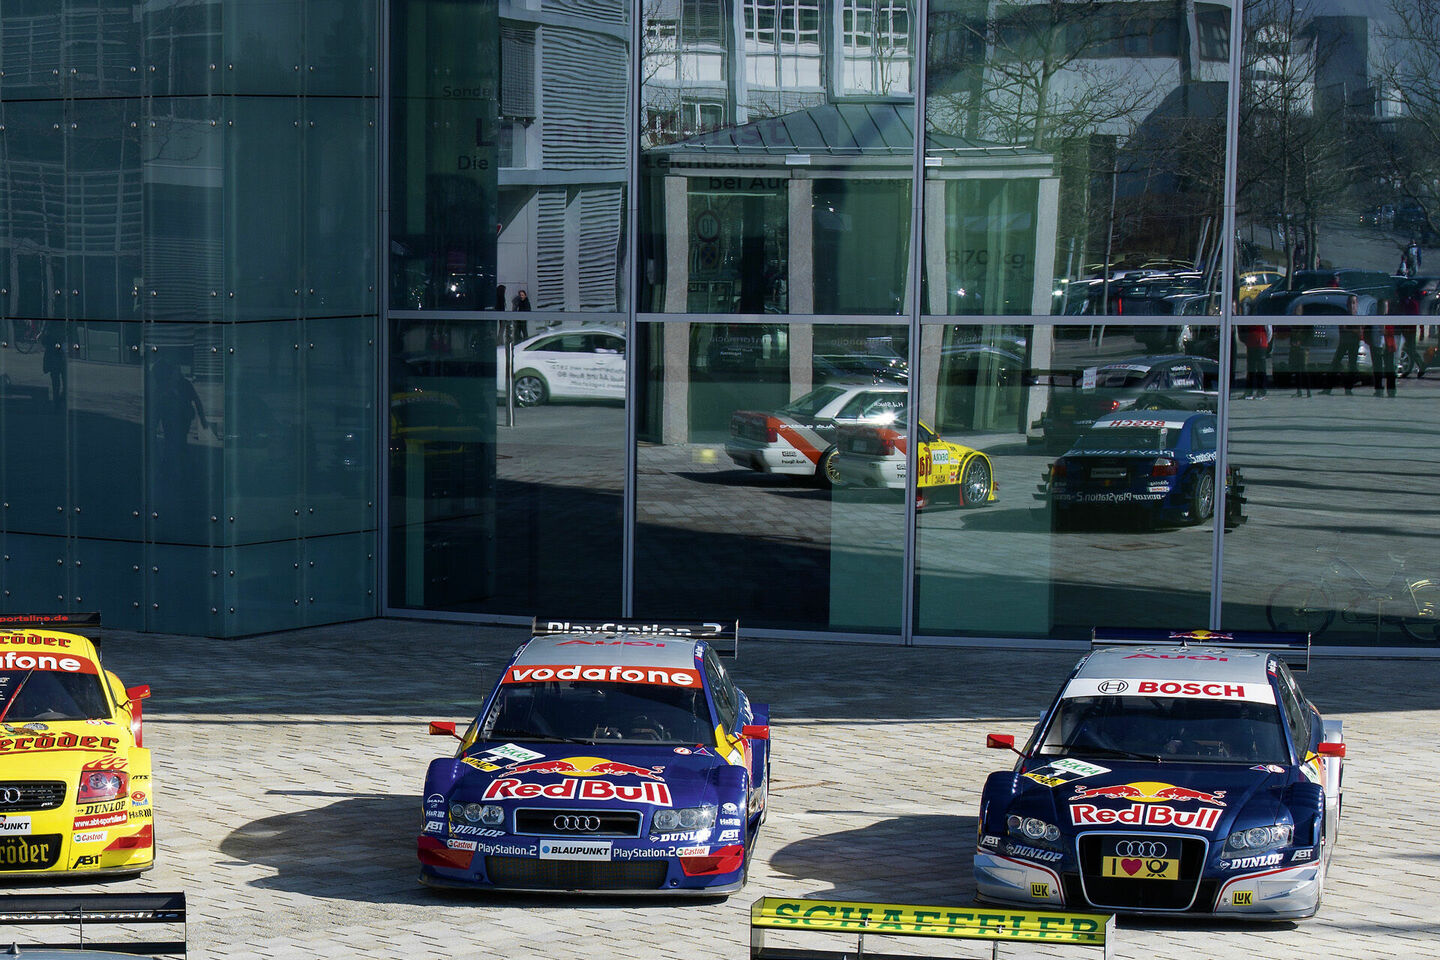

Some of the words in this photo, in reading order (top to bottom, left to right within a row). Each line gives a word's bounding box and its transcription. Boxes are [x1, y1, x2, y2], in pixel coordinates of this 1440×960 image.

[513, 665, 694, 686] vodafone
[1138, 681, 1245, 697] BOSCH
[482, 778, 578, 799] Red
[580, 780, 672, 806] Bull
[85, 801, 126, 815] DUNLOP
[1071, 804, 1143, 825] Red
[1146, 805, 1221, 830] Bull
[81, 833, 103, 842] Castrol
[454, 824, 507, 838] DUNLOP
[453, 841, 473, 850] Castrol
[551, 846, 610, 856] BLAUPUNKT
[1013, 845, 1063, 862] DUNLOP
[1230, 853, 1284, 869] DUNLOP
[773, 902, 1098, 942] SCHAEFFLER
